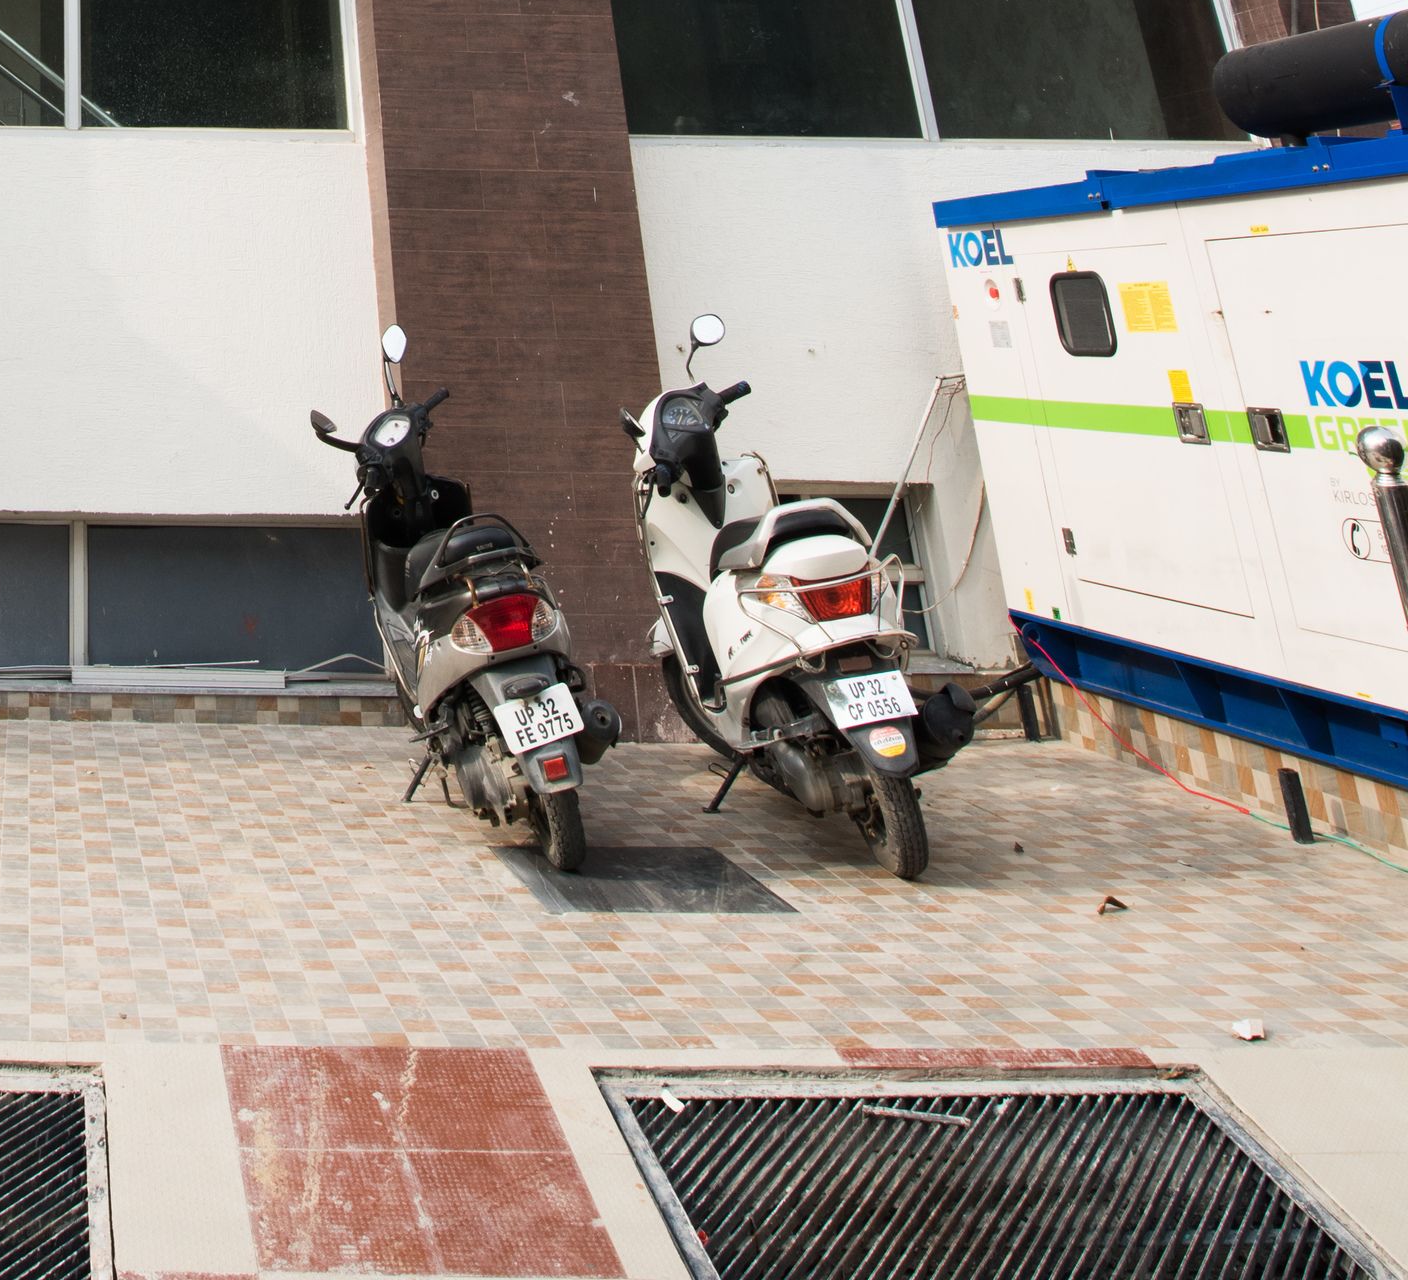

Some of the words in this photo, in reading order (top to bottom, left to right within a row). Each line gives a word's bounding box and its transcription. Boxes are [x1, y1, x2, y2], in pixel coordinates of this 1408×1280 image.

[947, 229, 1014, 268] KOEL
[1299, 360, 1408, 410] KOEL
[848, 681, 866, 699] UP
[867, 678, 885, 696] 32
[514, 706, 535, 727] UP
[538, 698, 559, 718] 32
[867, 696, 901, 718] 0556
[515, 726, 537, 747] FE
[537, 712, 574, 739] 9775
